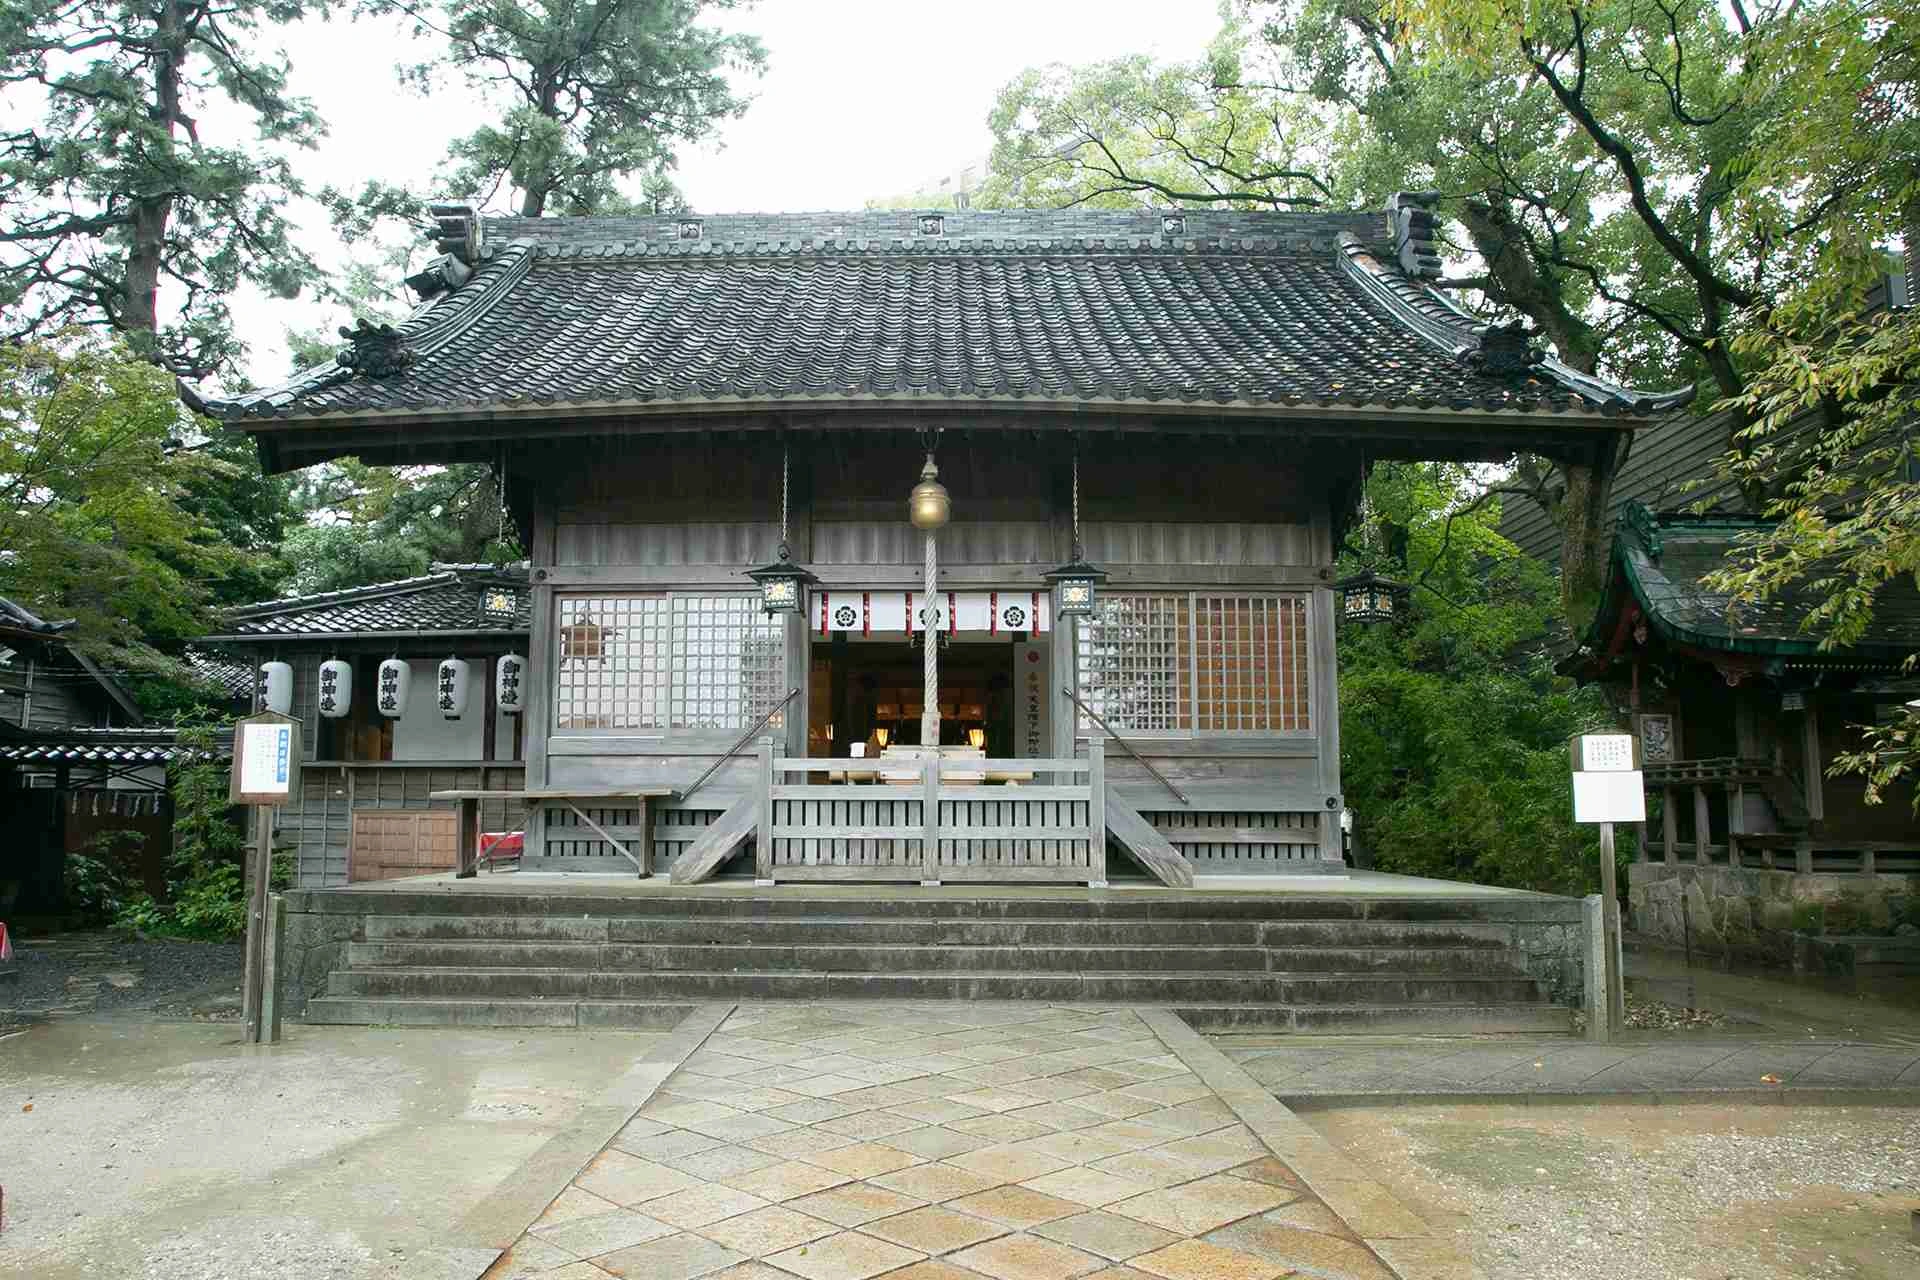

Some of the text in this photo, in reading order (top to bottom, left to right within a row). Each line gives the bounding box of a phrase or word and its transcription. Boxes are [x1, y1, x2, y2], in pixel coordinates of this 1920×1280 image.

[380, 665, 399, 711] 御神燈
[438, 665, 456, 711] 御神燈
[499, 659, 521, 705] 御神燈
